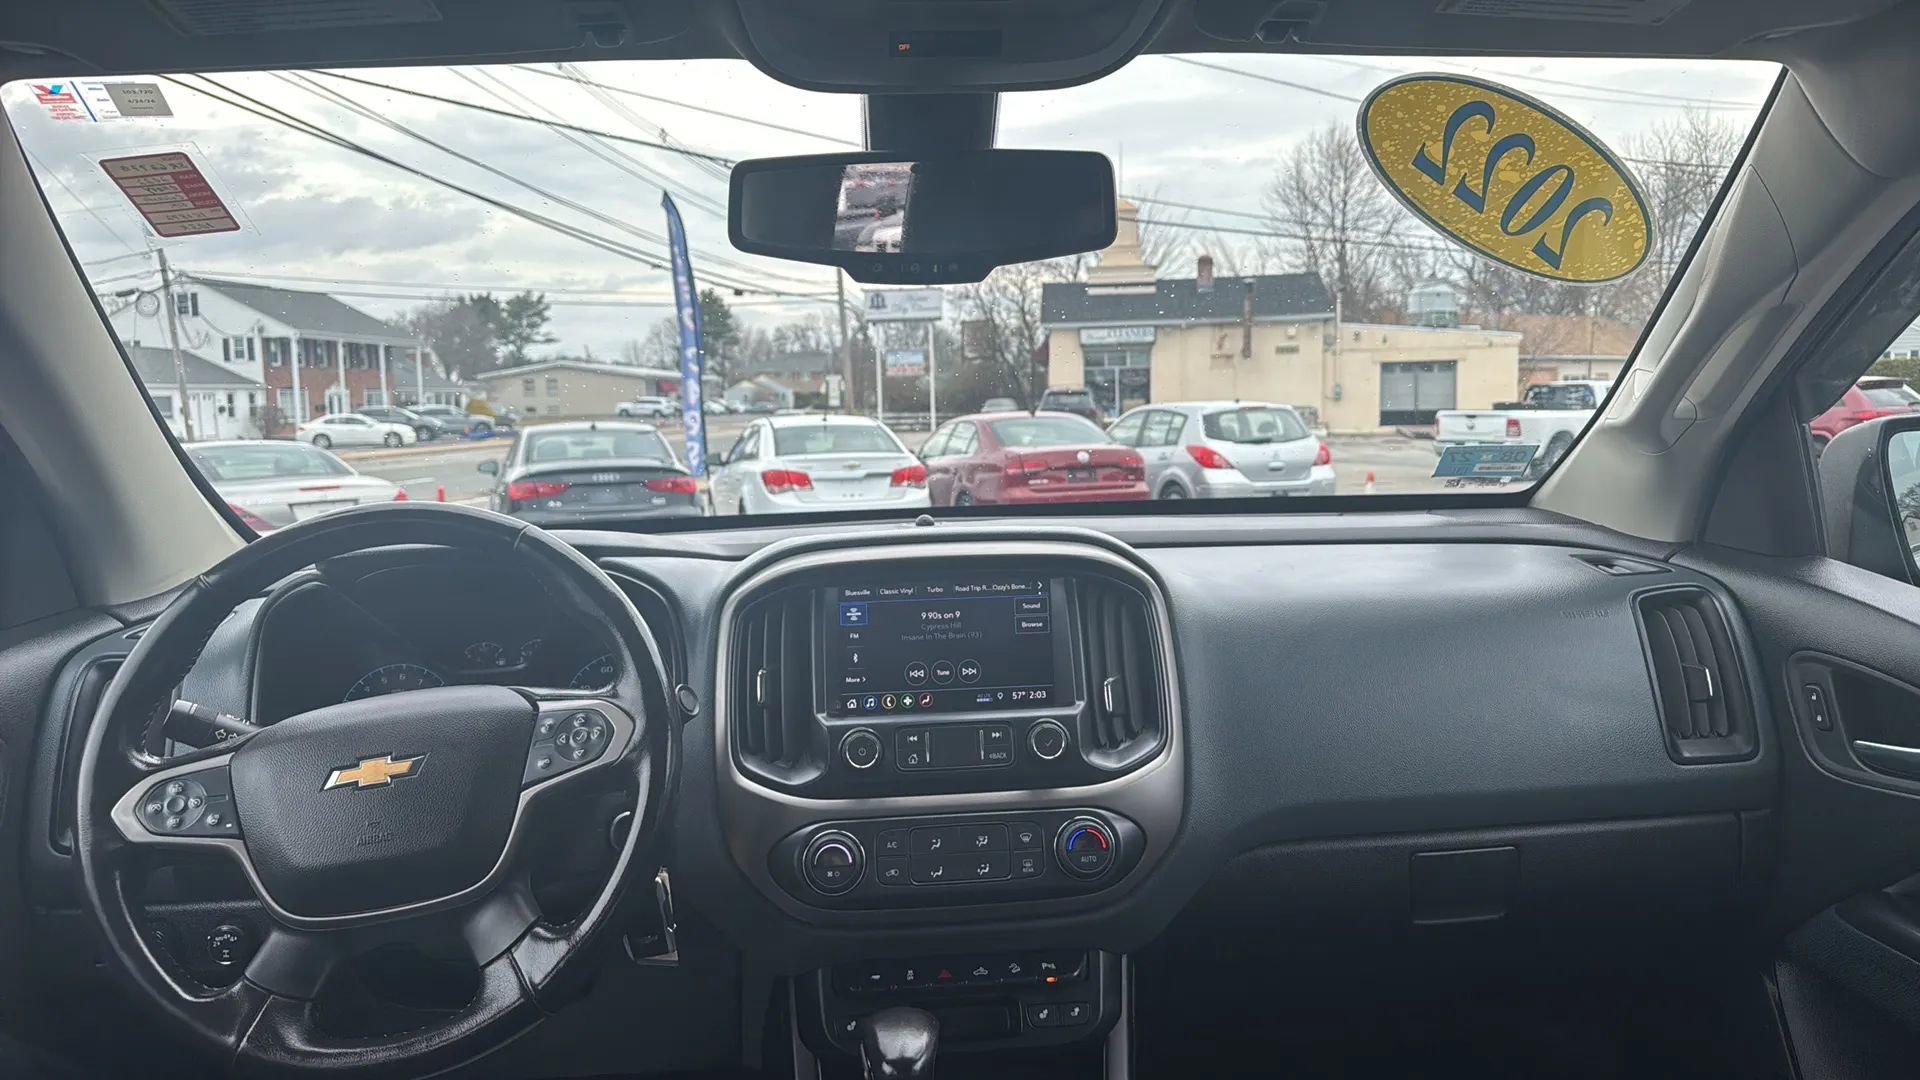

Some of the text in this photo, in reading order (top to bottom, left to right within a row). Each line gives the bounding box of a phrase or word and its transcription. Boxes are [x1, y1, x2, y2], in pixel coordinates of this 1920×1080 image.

[898, 43, 910, 51] OFF
[899, 587, 914, 595] Vinyl
[970, 584, 981, 592] Trip
[921, 621, 962, 631] Cypress Hill
[934, 632, 946, 640] The
[948, 631, 966, 639] Brain
[1012, 690, 1047, 700] 57° 2:03
[992, 751, 1008, 759] BACK
[886, 841, 898, 849] A/C
[1081, 855, 1097, 863] AUTO
